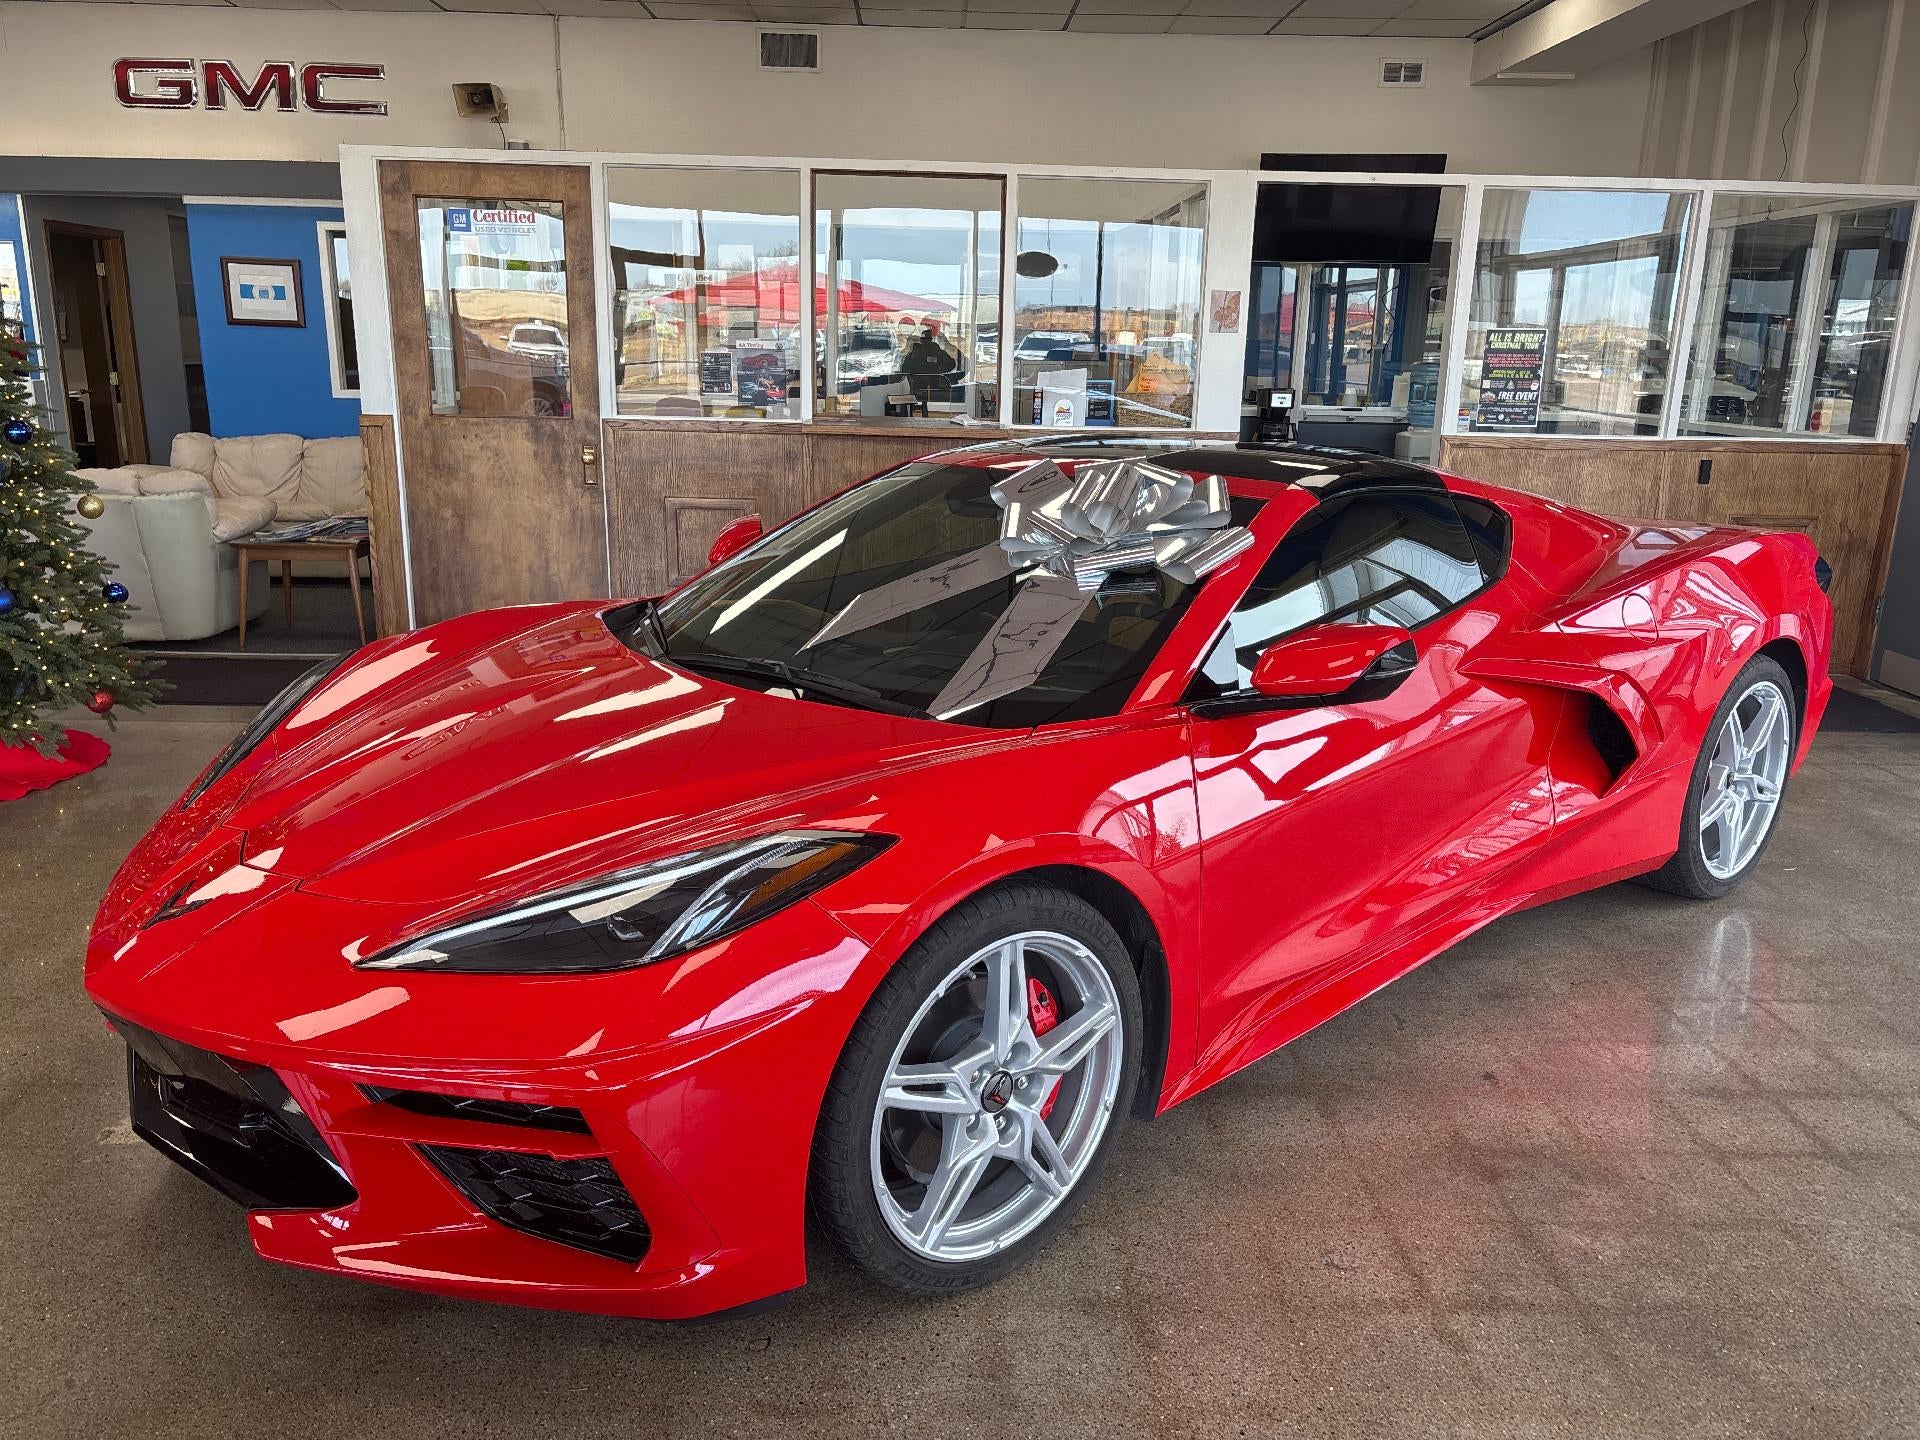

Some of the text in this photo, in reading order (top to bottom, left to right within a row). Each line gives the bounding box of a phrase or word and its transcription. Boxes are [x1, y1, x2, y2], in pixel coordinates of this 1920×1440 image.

[113, 58, 388, 116] GMC
[453, 213, 467, 224] GM
[472, 208, 536, 224] Certified
[498, 226, 537, 234] VEHICLES
[1489, 332, 1544, 343] ALL IS BRIGHT
[1497, 391, 1539, 401] FREE EVENT
